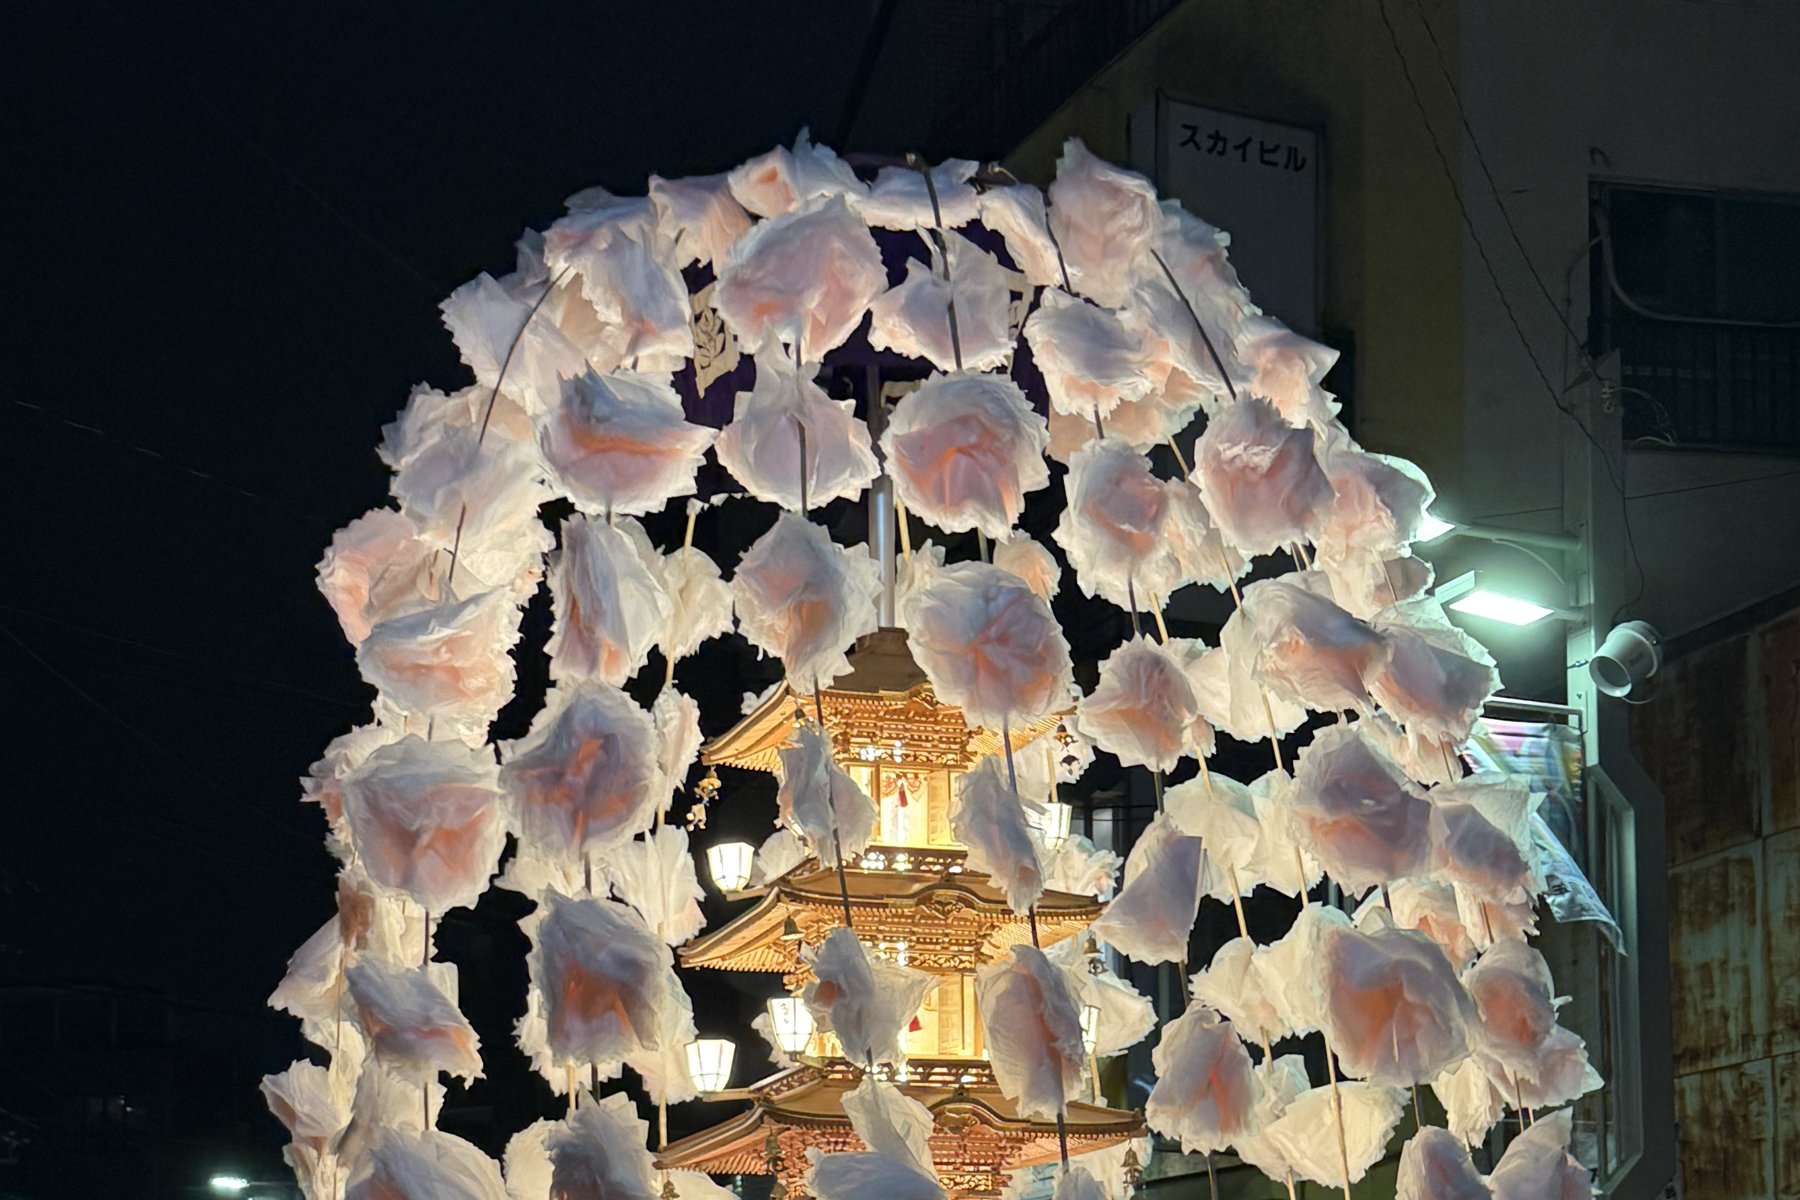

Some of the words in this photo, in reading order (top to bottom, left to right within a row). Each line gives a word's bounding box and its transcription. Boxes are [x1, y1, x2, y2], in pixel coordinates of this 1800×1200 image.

[1179, 124, 1306, 171] スカイビル
